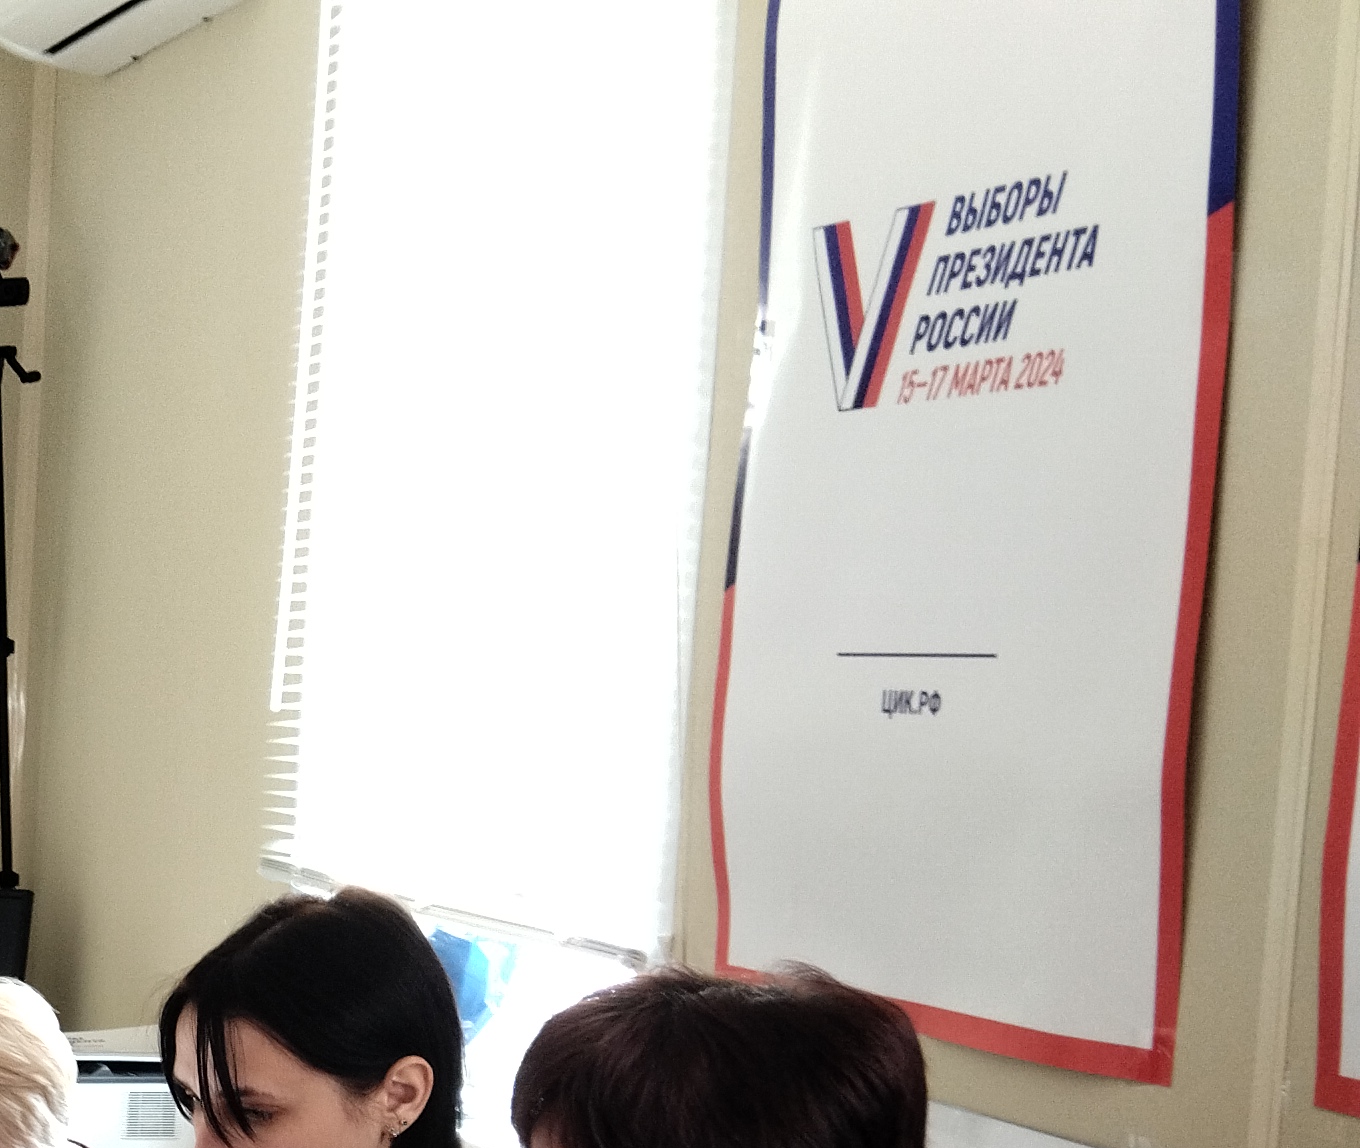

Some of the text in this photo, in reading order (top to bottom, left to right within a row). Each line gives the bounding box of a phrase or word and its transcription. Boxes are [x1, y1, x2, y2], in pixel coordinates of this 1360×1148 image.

[944, 169, 1069, 237] ВЫБОРЫ
[925, 223, 1100, 296] ПРЕЗИДЕНТА
[909, 298, 1019, 355] РОССИИ
[896, 347, 1066, 405] 15–17 МАРТА 2024
[881, 689, 942, 719] ЦИК.РФ
